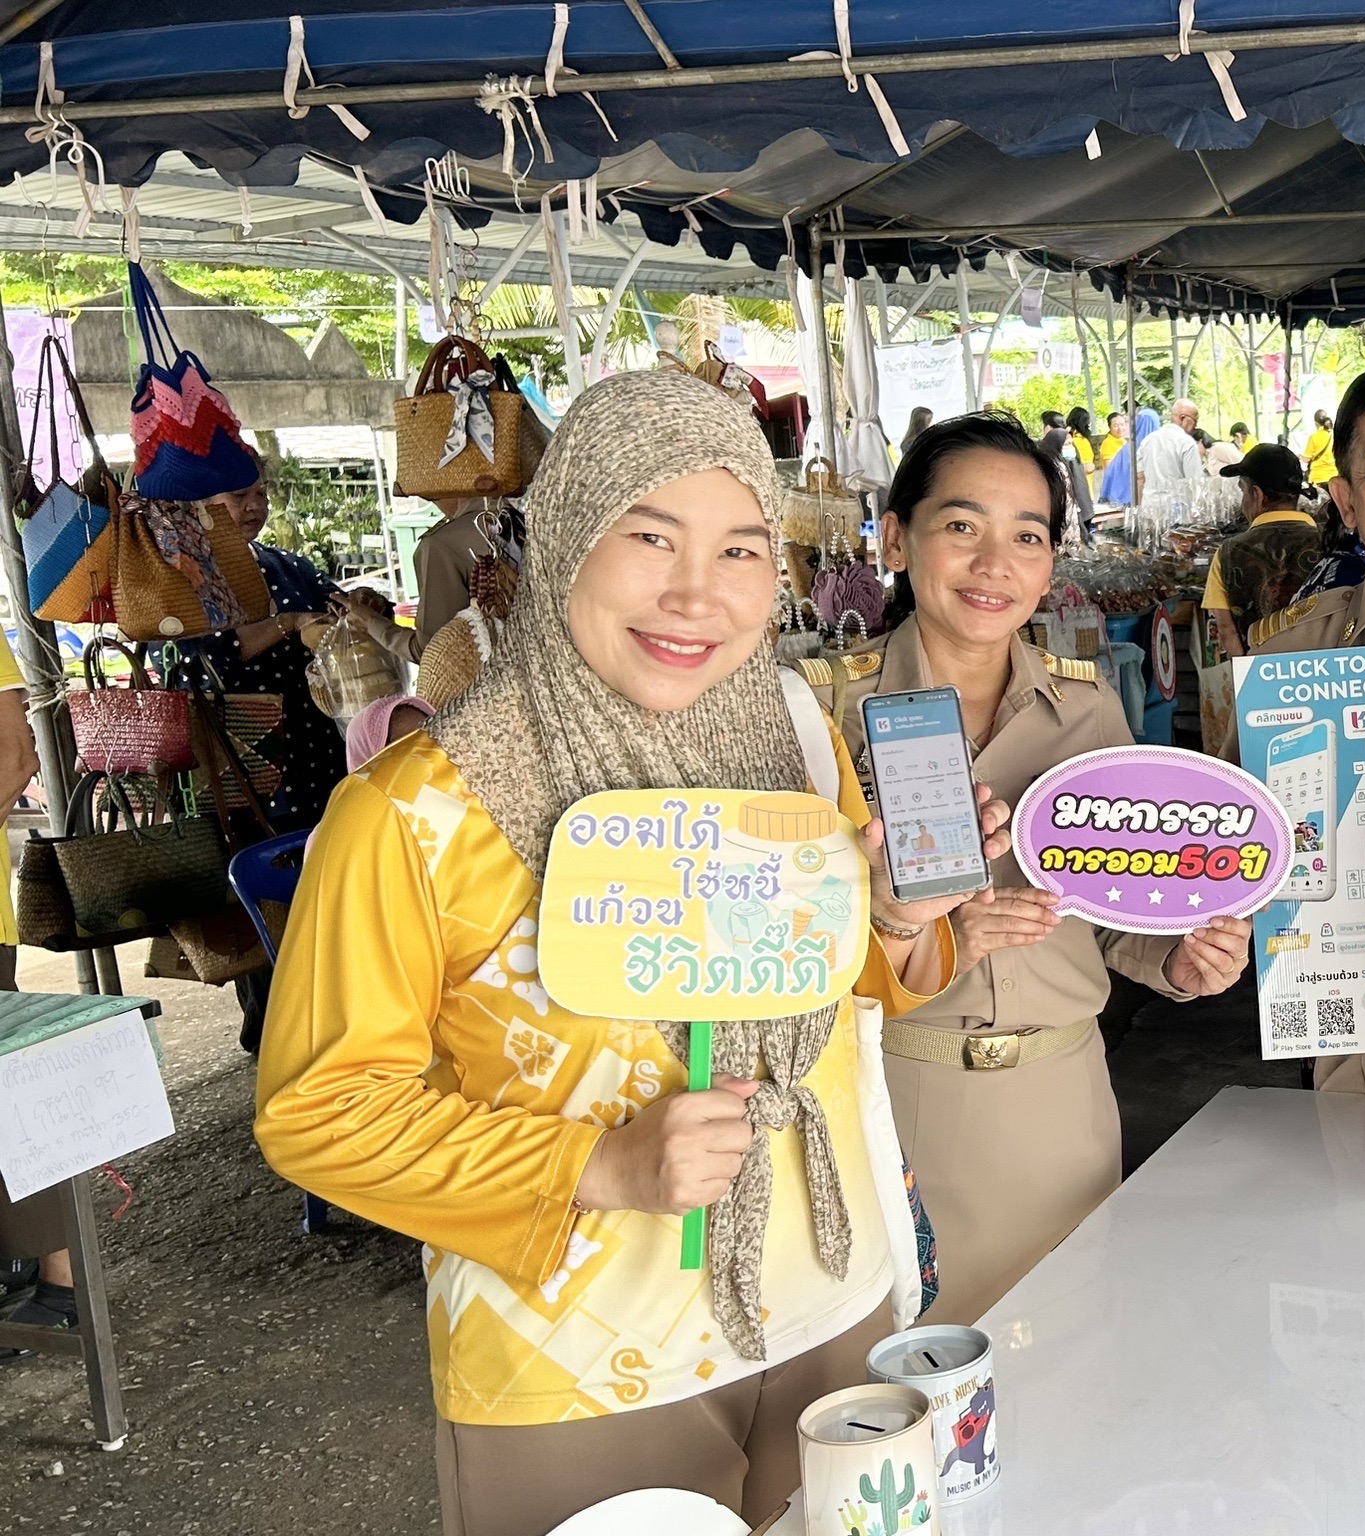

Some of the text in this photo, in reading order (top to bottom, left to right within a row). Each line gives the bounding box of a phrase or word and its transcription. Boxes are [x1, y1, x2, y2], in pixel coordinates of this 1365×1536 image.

[1259, 657, 1330, 682] CLICK
[1256, 710, 1303, 725] คลิกชุมชน
[567, 799, 722, 851] ออมได้
[1053, 793, 1256, 838] มหกรรม
[672, 853, 783, 900] ใช้หนี้
[573, 884, 685, 926] แก้จน
[1296, 969, 1359, 985] เข้าสู่ระบบด้วย
[930, 1375, 980, 1411] LIVE MUSIC
[946, 1481, 972, 1498] MUSIC
[973, 1474, 981, 1486] IN
